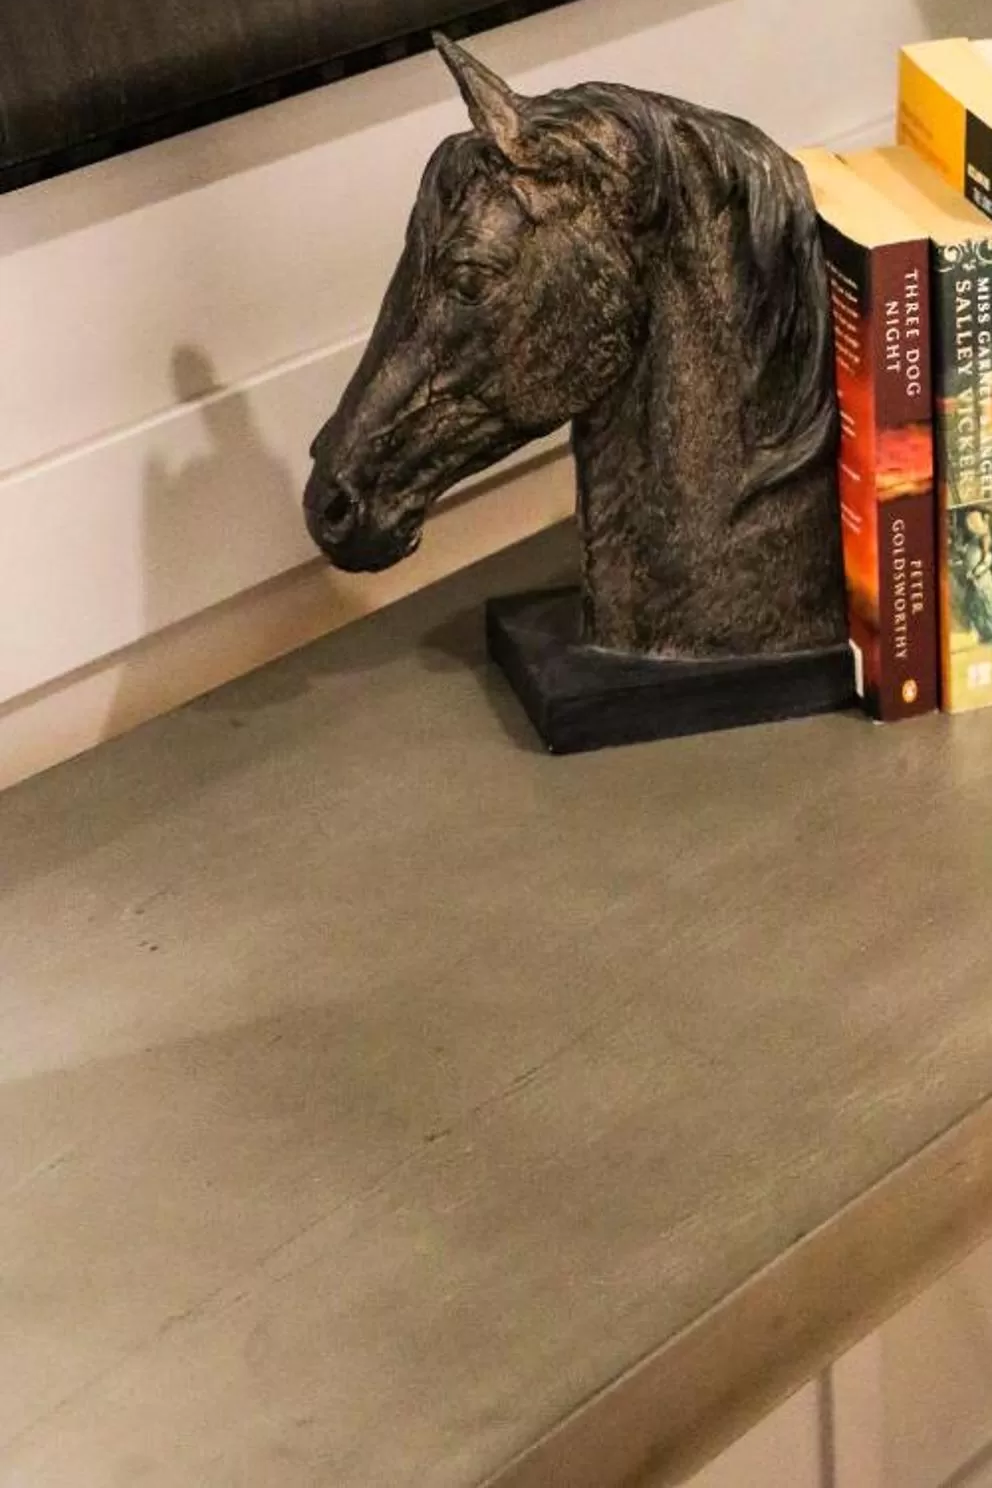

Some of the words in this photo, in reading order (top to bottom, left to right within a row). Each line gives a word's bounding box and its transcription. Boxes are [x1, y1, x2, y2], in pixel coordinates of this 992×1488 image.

[904, 268, 920, 338] THREE
[955, 279, 973, 376] SALLEY
[977, 277, 991, 324] MISS
[885, 300, 901, 373] NIGHT
[906, 348, 921, 396] DOG
[977, 331, 992, 426] GARNETS
[957, 386, 976, 501] VICKERS
[980, 434, 992, 498] ANGEL
[891, 518, 908, 659] GOLDSWORTHY
[909, 559, 924, 614] PETER
